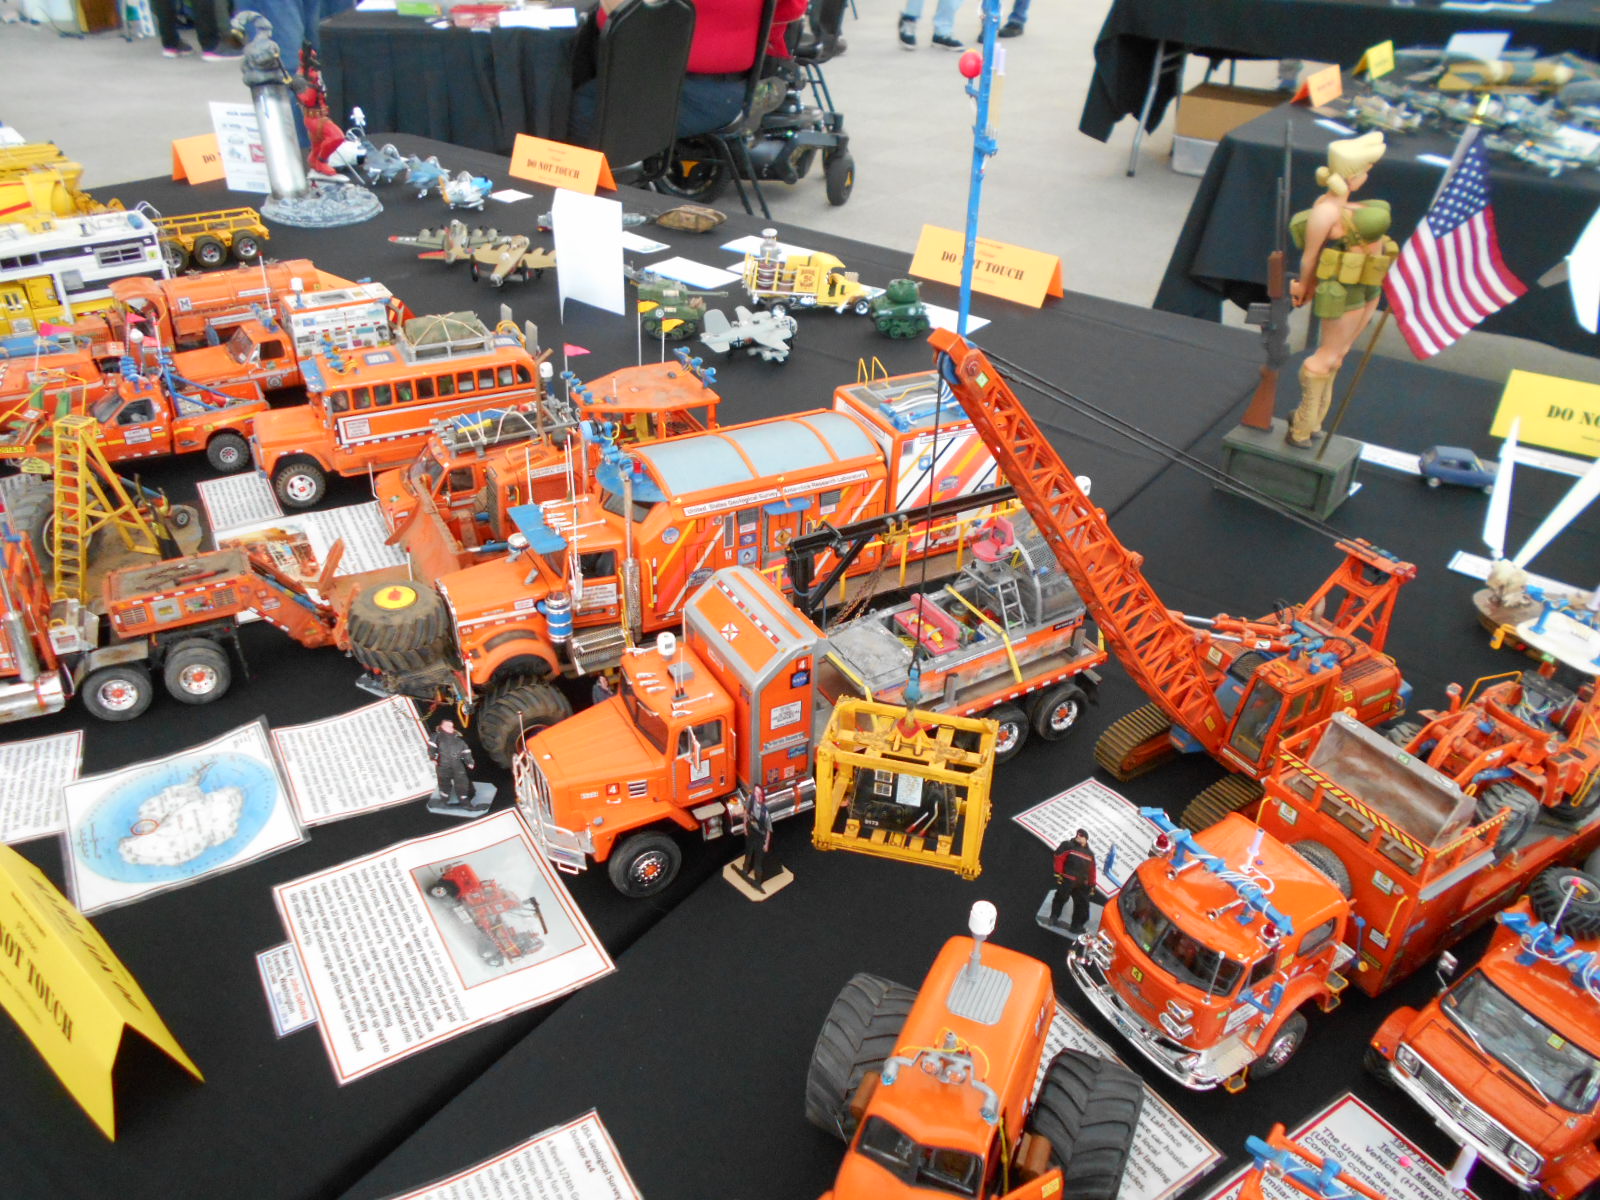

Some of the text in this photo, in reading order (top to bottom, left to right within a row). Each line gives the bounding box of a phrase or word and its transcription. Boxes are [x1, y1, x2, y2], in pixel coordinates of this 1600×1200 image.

[526, 158, 580, 179] DO NOT TOUCH
[941, 250, 957, 264] DO
[986, 261, 1024, 280] TOUCH
[1546, 404, 1574, 422] DO
[758, 491, 778, 499] Survey
[798, 660, 806, 669] 4
[608, 784, 617, 794] 4
[1134, 970, 1142, 980] 4
[27, 958, 74, 1044] TOUCH
[1083, 1036, 1097, 1051] with
[1149, 1116, 1181, 1147] LaFrance
[1166, 1116, 1179, 1130] for
[1178, 1129, 1194, 1144] sale
[588, 1139, 611, 1175] Geological
[1140, 1137, 1160, 1156] local
[1151, 1133, 1188, 1170] car hauler
[1310, 1129, 1347, 1162] (USGS)
[1321, 1127, 1339, 1143] The
[1340, 1143, 1373, 1172] United
[532, 1146, 552, 1178] extremely
[584, 1159, 595, 1172] 4x4
[1141, 1155, 1170, 1183] landing
